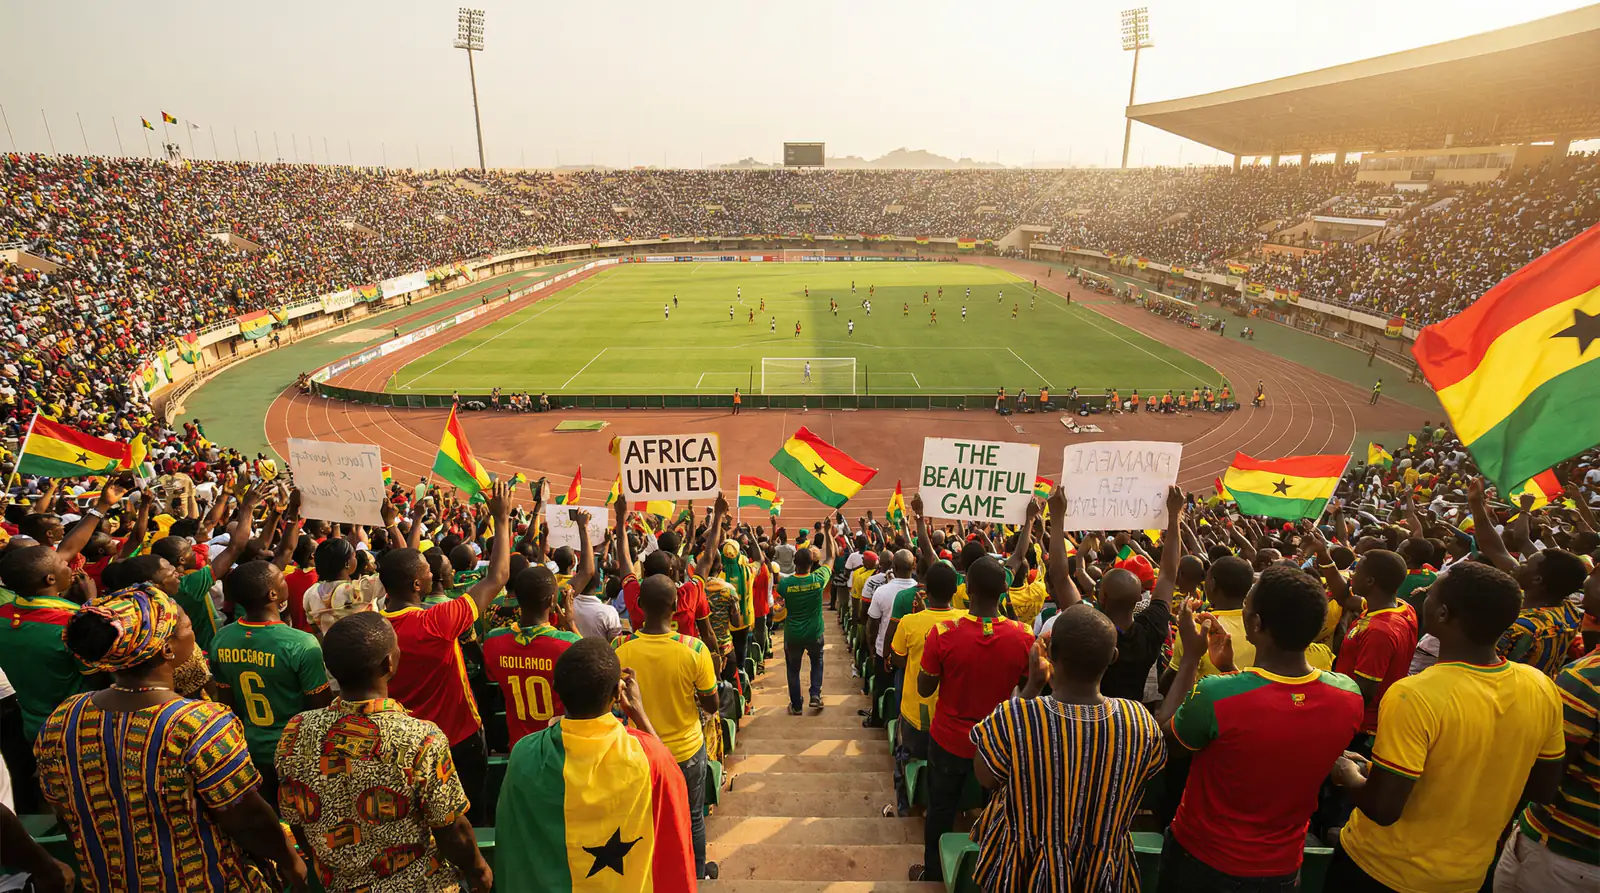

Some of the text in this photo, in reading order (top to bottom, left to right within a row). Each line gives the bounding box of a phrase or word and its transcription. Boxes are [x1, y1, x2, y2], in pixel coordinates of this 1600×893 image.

[624, 437, 716, 464] AFRICA
[954, 443, 1000, 466] THE
[627, 466, 717, 494] UNITED
[923, 465, 1031, 494] BEAUTIFUL
[941, 492, 1006, 519] GAME
[239, 671, 275, 726] 6
[507, 675, 554, 721] 10
